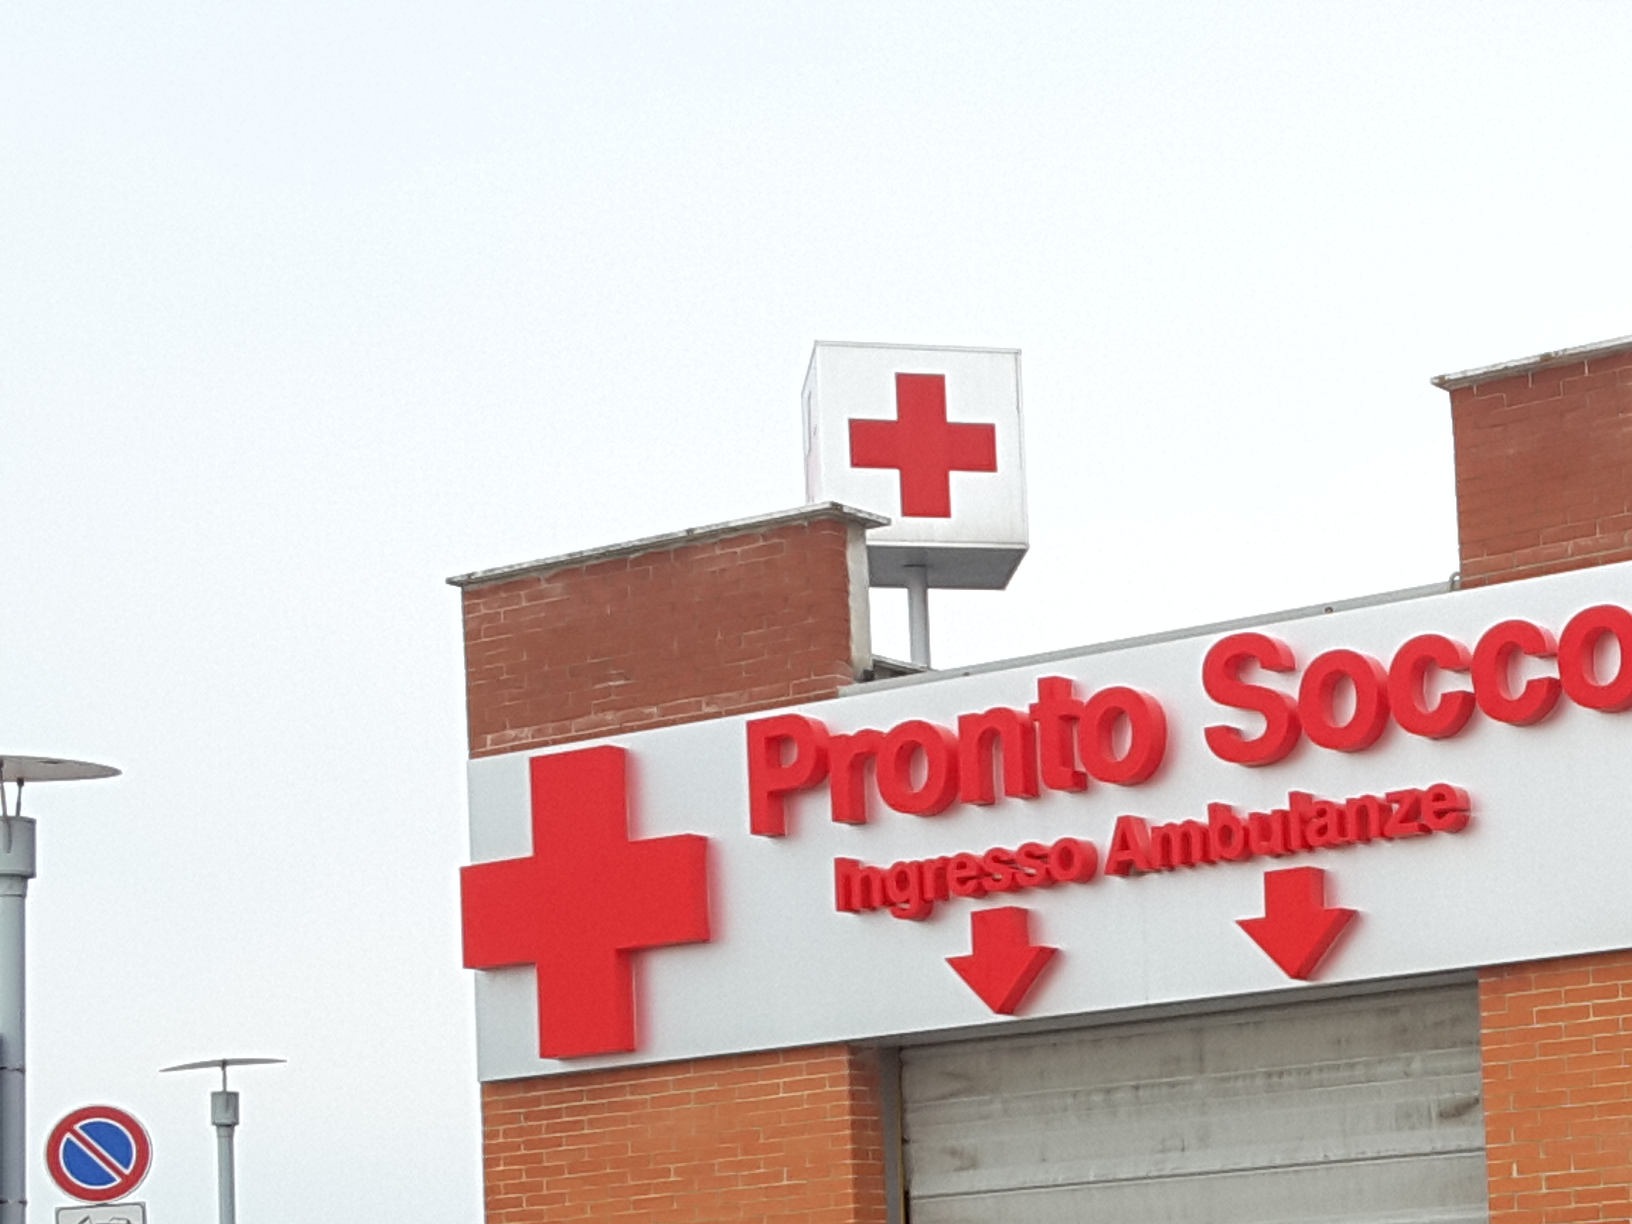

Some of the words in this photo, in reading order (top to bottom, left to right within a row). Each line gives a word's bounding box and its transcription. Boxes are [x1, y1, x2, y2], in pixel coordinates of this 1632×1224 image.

[746, 676, 1168, 838] Pronto
[834, 837, 1098, 922] Ingresso
[1105, 782, 1472, 878] Ambulanze
